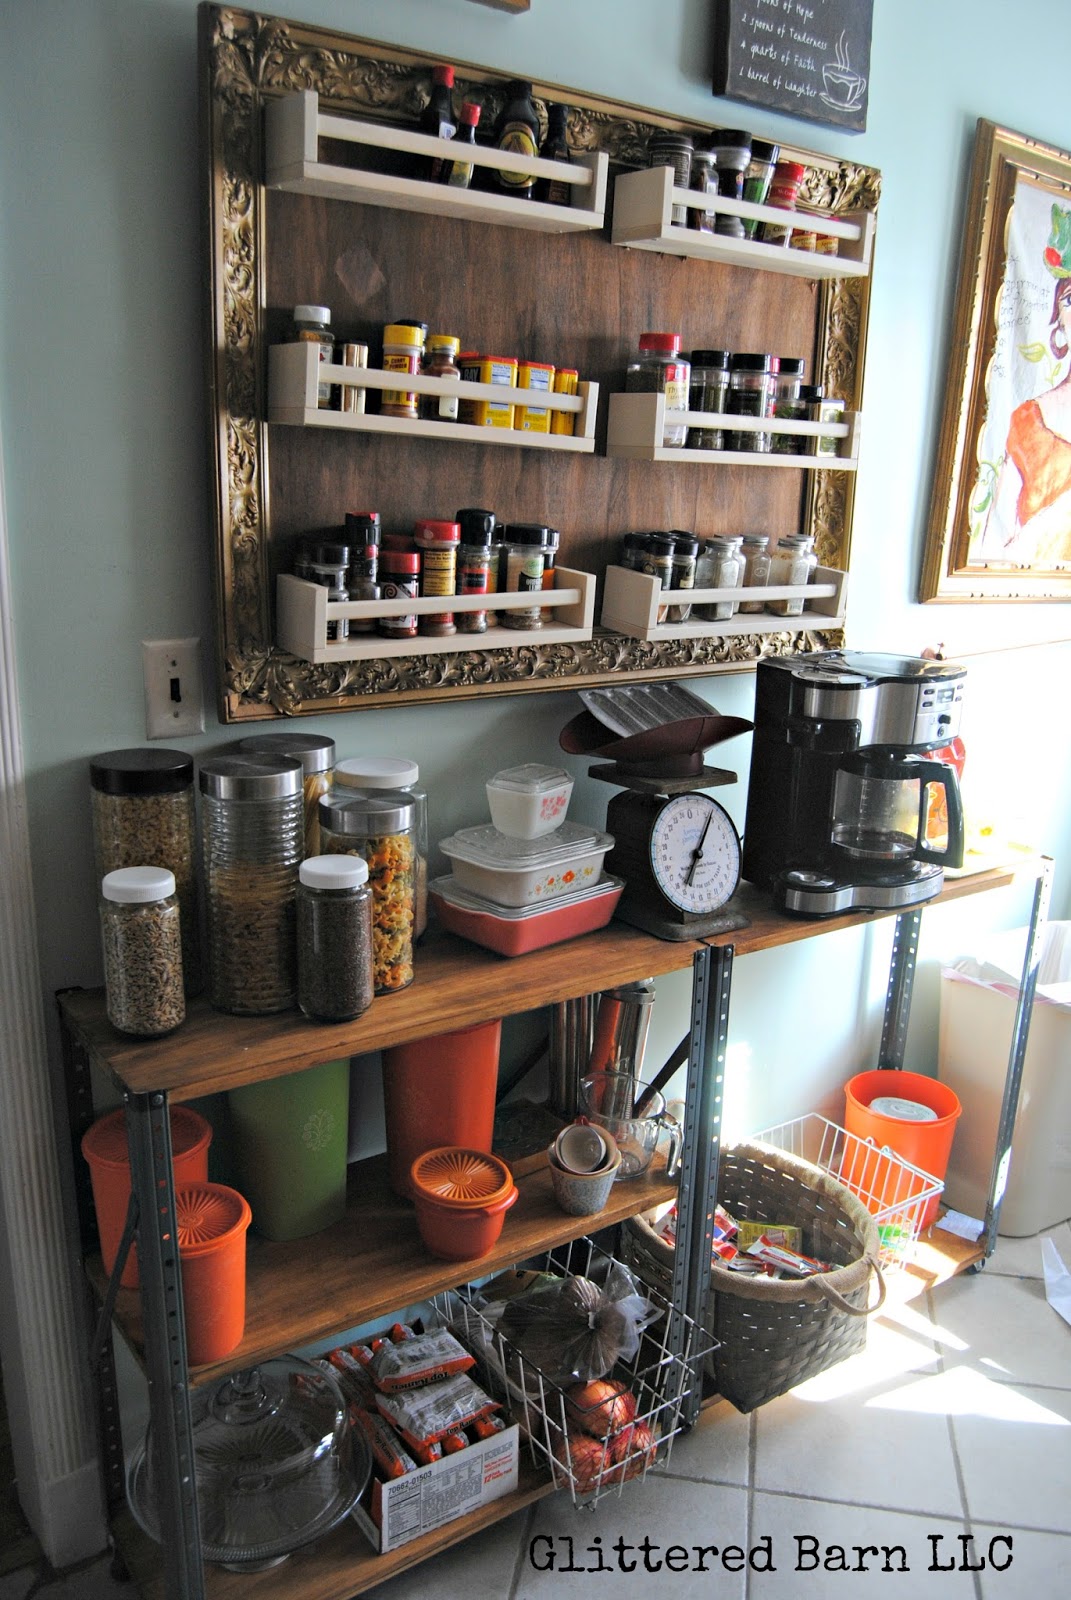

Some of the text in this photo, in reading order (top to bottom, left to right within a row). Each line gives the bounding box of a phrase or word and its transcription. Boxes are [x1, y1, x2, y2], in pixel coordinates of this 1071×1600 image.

[783, 0, 792, 14] of
[796, 3, 814, 24] Hope
[741, 13, 827, 50] 2 spoons of Tenderness
[750, 43, 777, 60] quarts
[781, 50, 790, 66] of
[794, 54, 816, 72] Faith
[747, 66, 769, 84] barrel
[773, 75, 781, 90] of
[785, 81, 817, 97] Laughter
[464, 368, 479, 382] BAY
[431, 1371, 449, 1381] Top
[446, 1425, 459, 1436] Top
